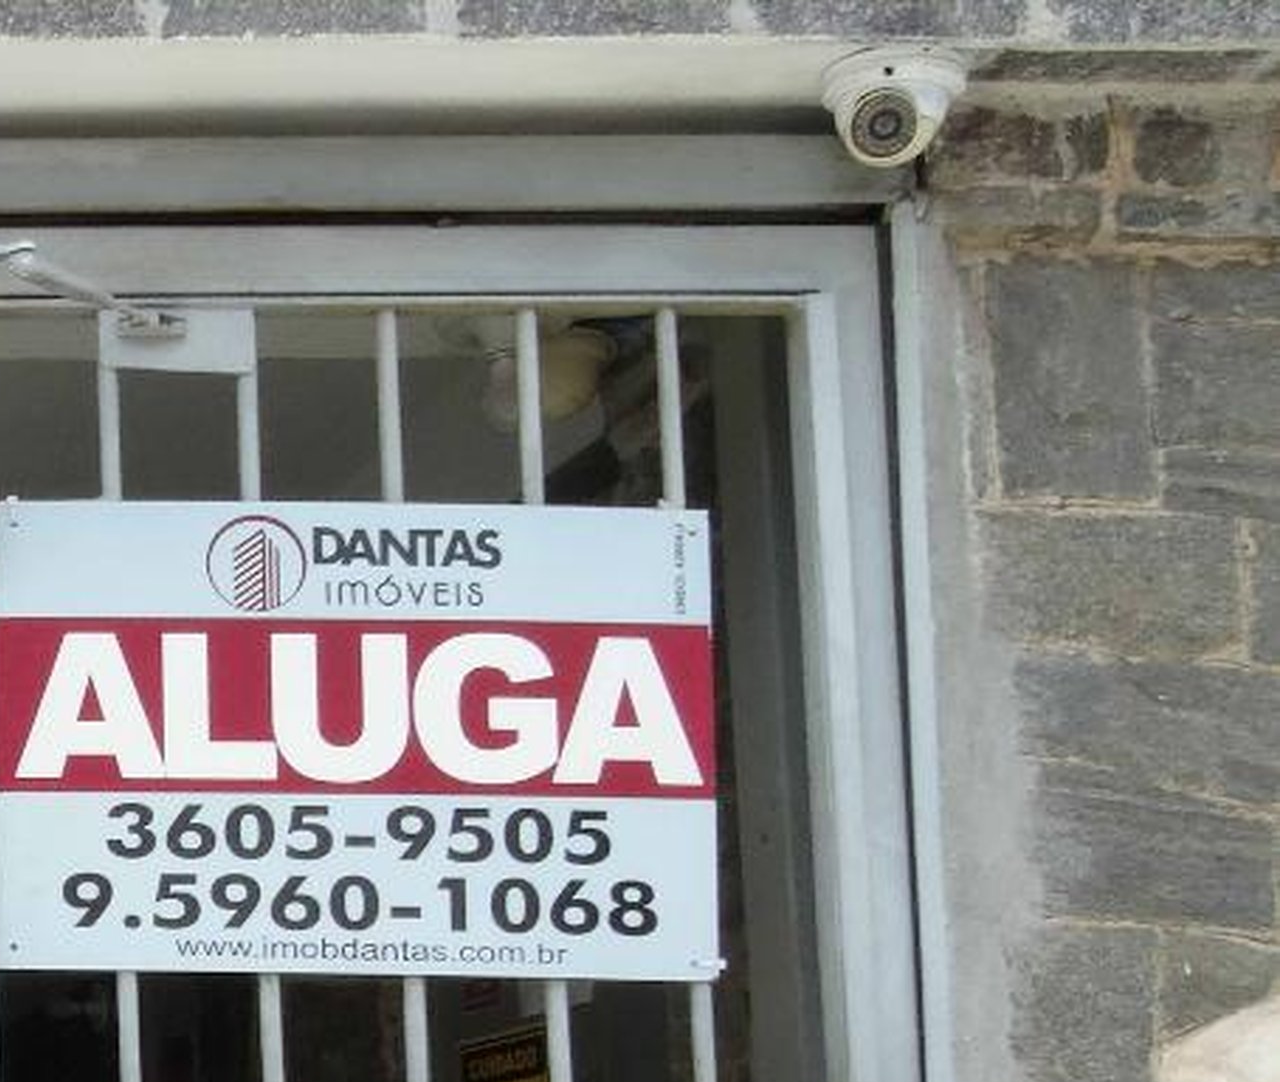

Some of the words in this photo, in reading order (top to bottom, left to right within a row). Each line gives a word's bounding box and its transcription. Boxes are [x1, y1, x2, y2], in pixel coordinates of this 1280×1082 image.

[312, 527, 503, 570] DANTAS
[324, 578, 485, 609] IMÓVEIS
[15, 632, 704, 785] ALUGA
[106, 803, 612, 865] 3605-9505
[61, 873, 658, 936] 9.5960-1068
[175, 938, 569, 966] www.imobdantas.com.br
